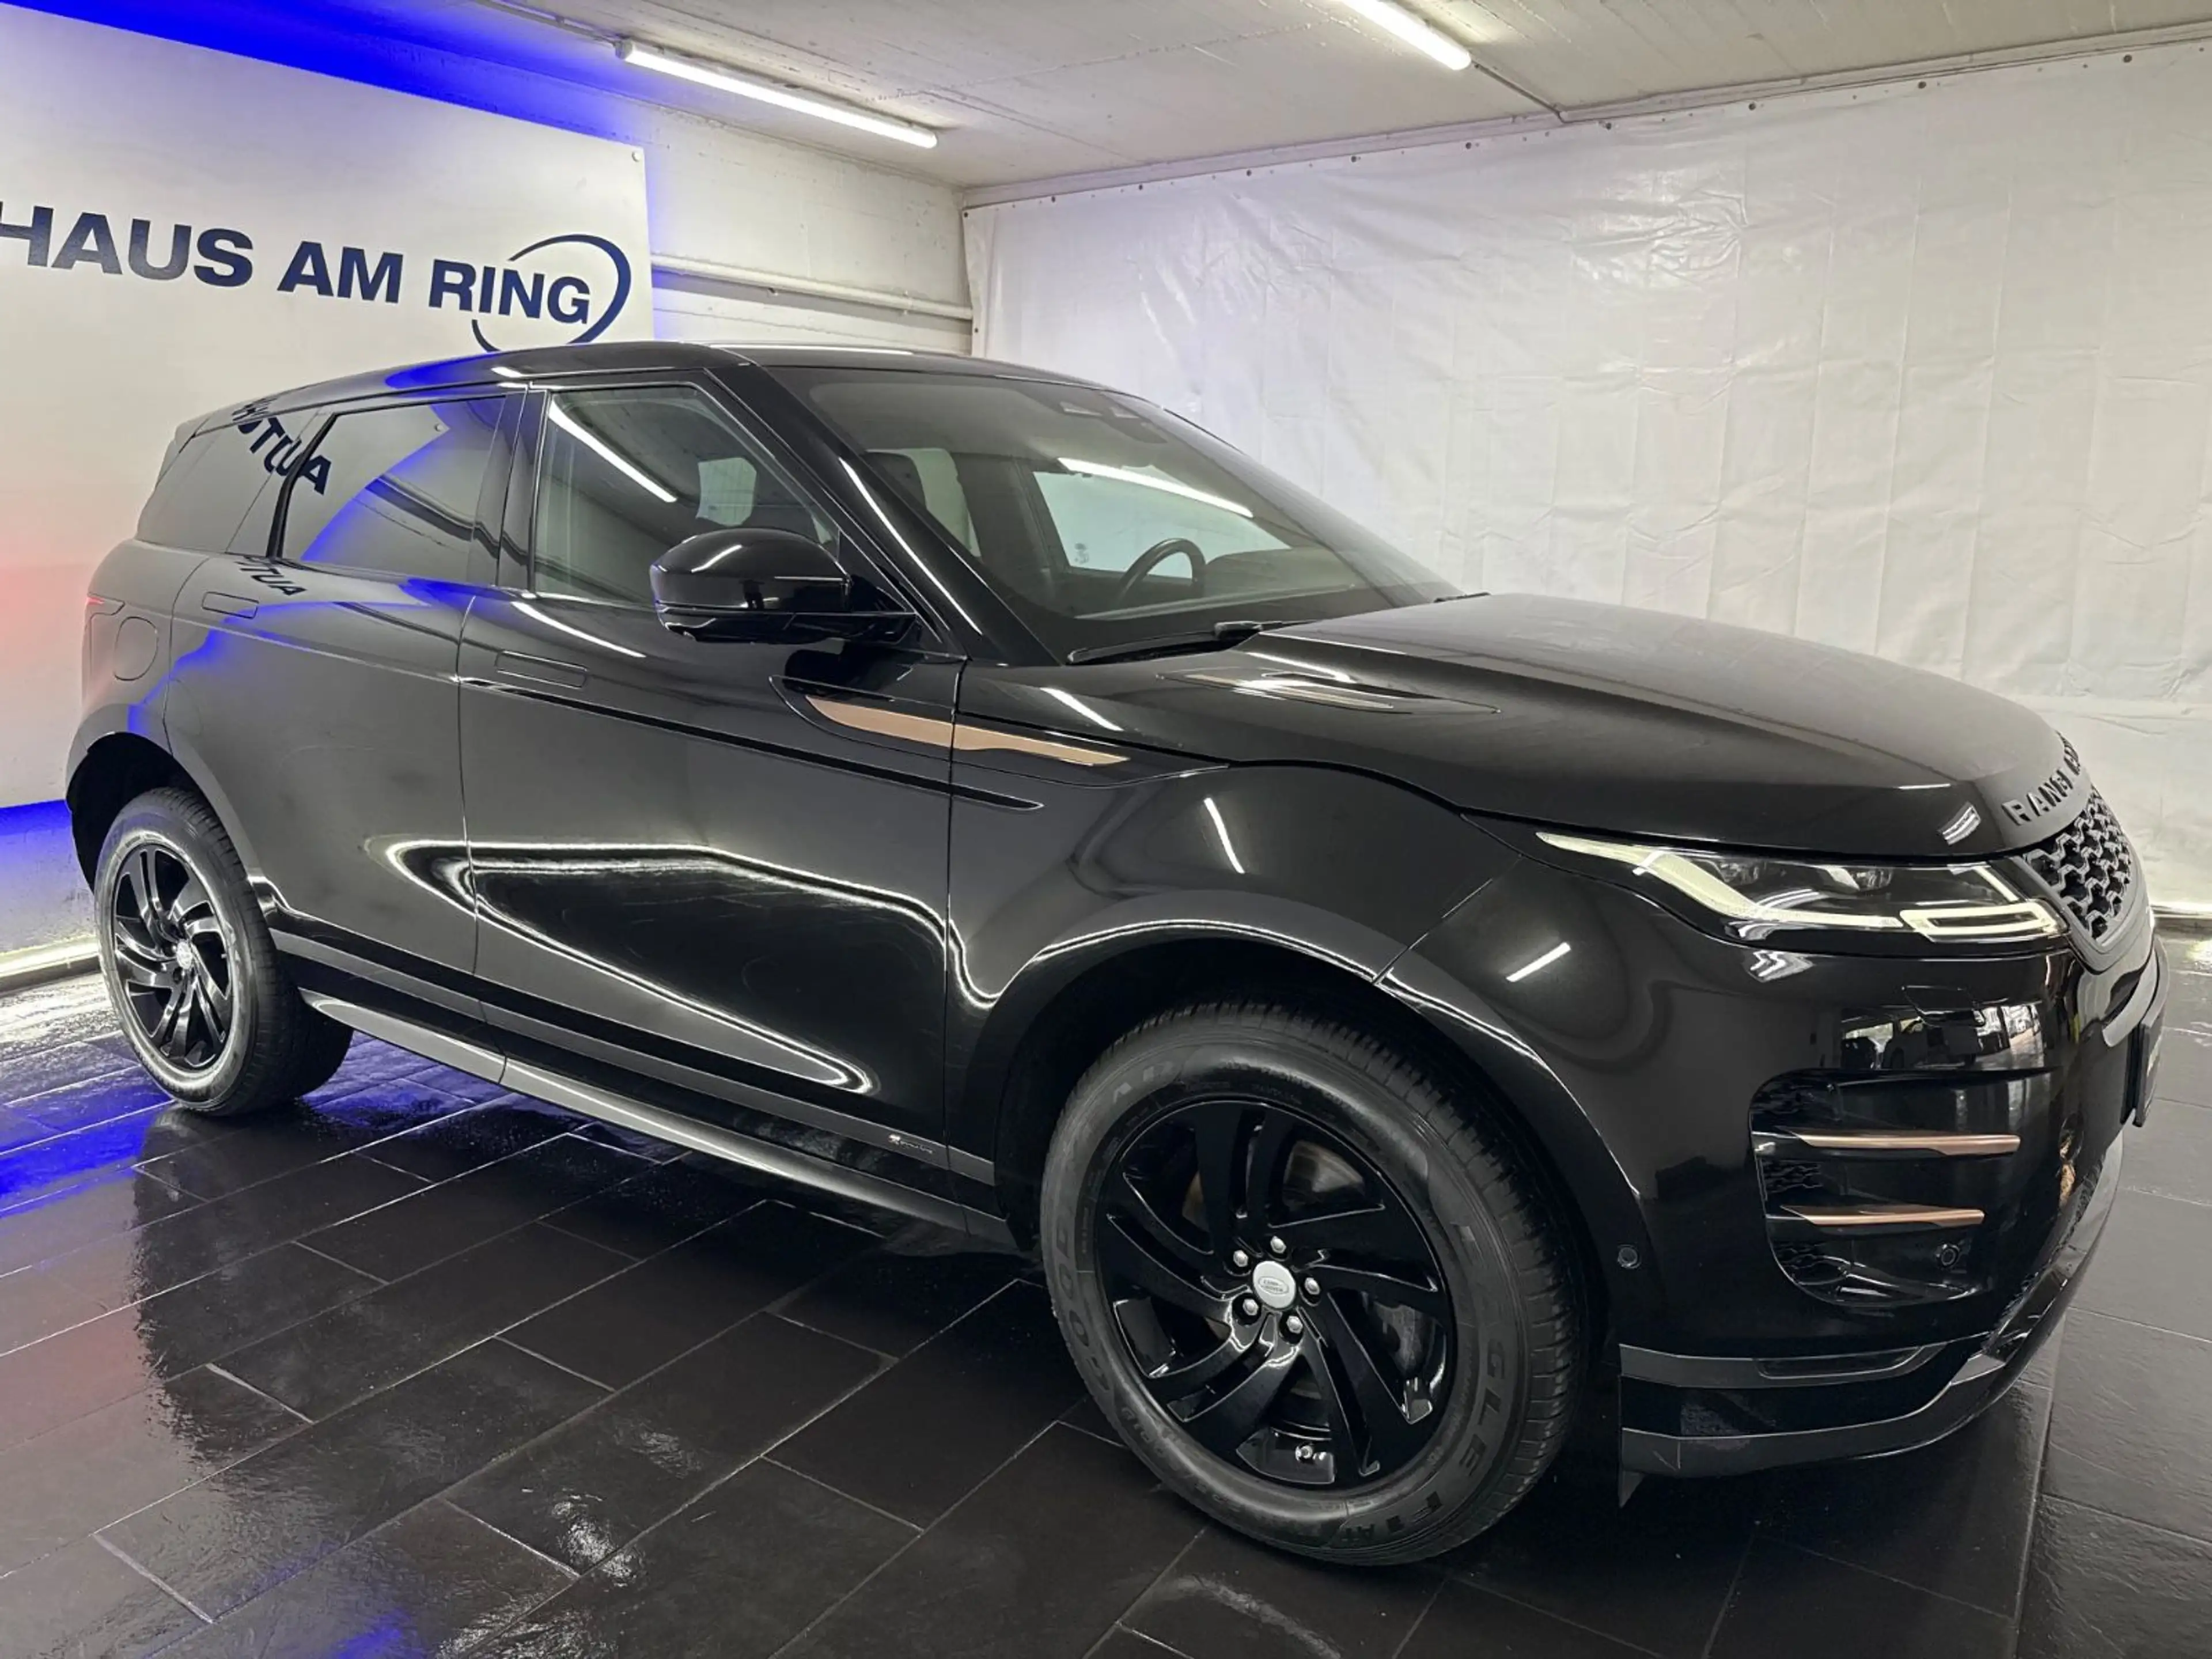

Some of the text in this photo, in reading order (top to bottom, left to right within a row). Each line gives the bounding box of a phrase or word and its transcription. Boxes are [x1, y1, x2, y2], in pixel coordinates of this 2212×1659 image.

[0, 201, 590, 324] HAUS AM RING
